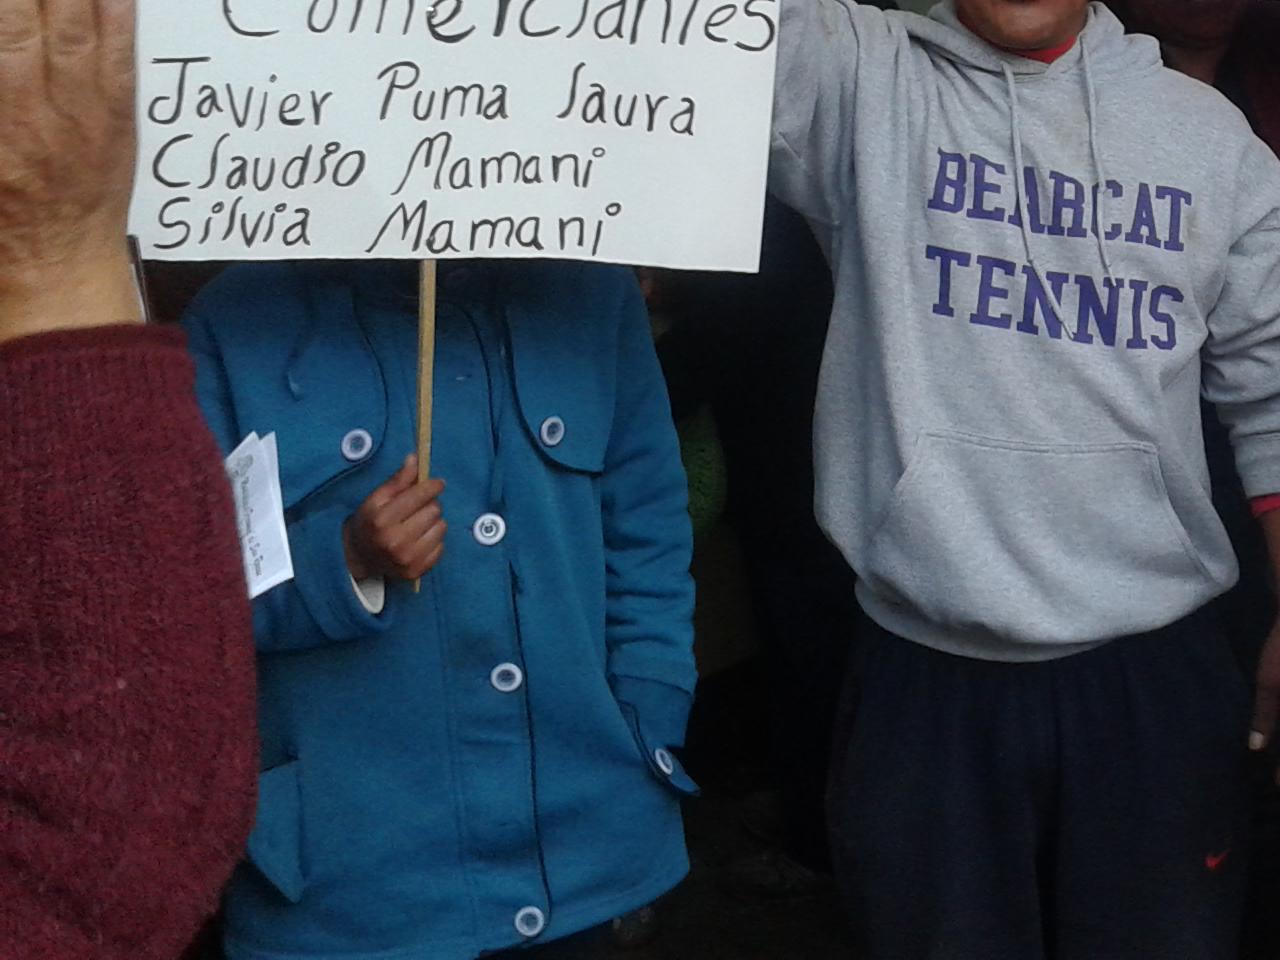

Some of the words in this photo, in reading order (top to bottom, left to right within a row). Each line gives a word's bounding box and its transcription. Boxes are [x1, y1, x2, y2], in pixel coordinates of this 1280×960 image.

[147, 56, 333, 128] Javier
[377, 61, 508, 122] Puma
[151, 133, 365, 190] Claudio
[390, 131, 606, 197] Mamani
[927, 147, 1193, 252] BEARCAT
[153, 196, 312, 250] Silvia
[365, 201, 622, 256] Mamani
[925, 245, 1185, 351] TENNIS
